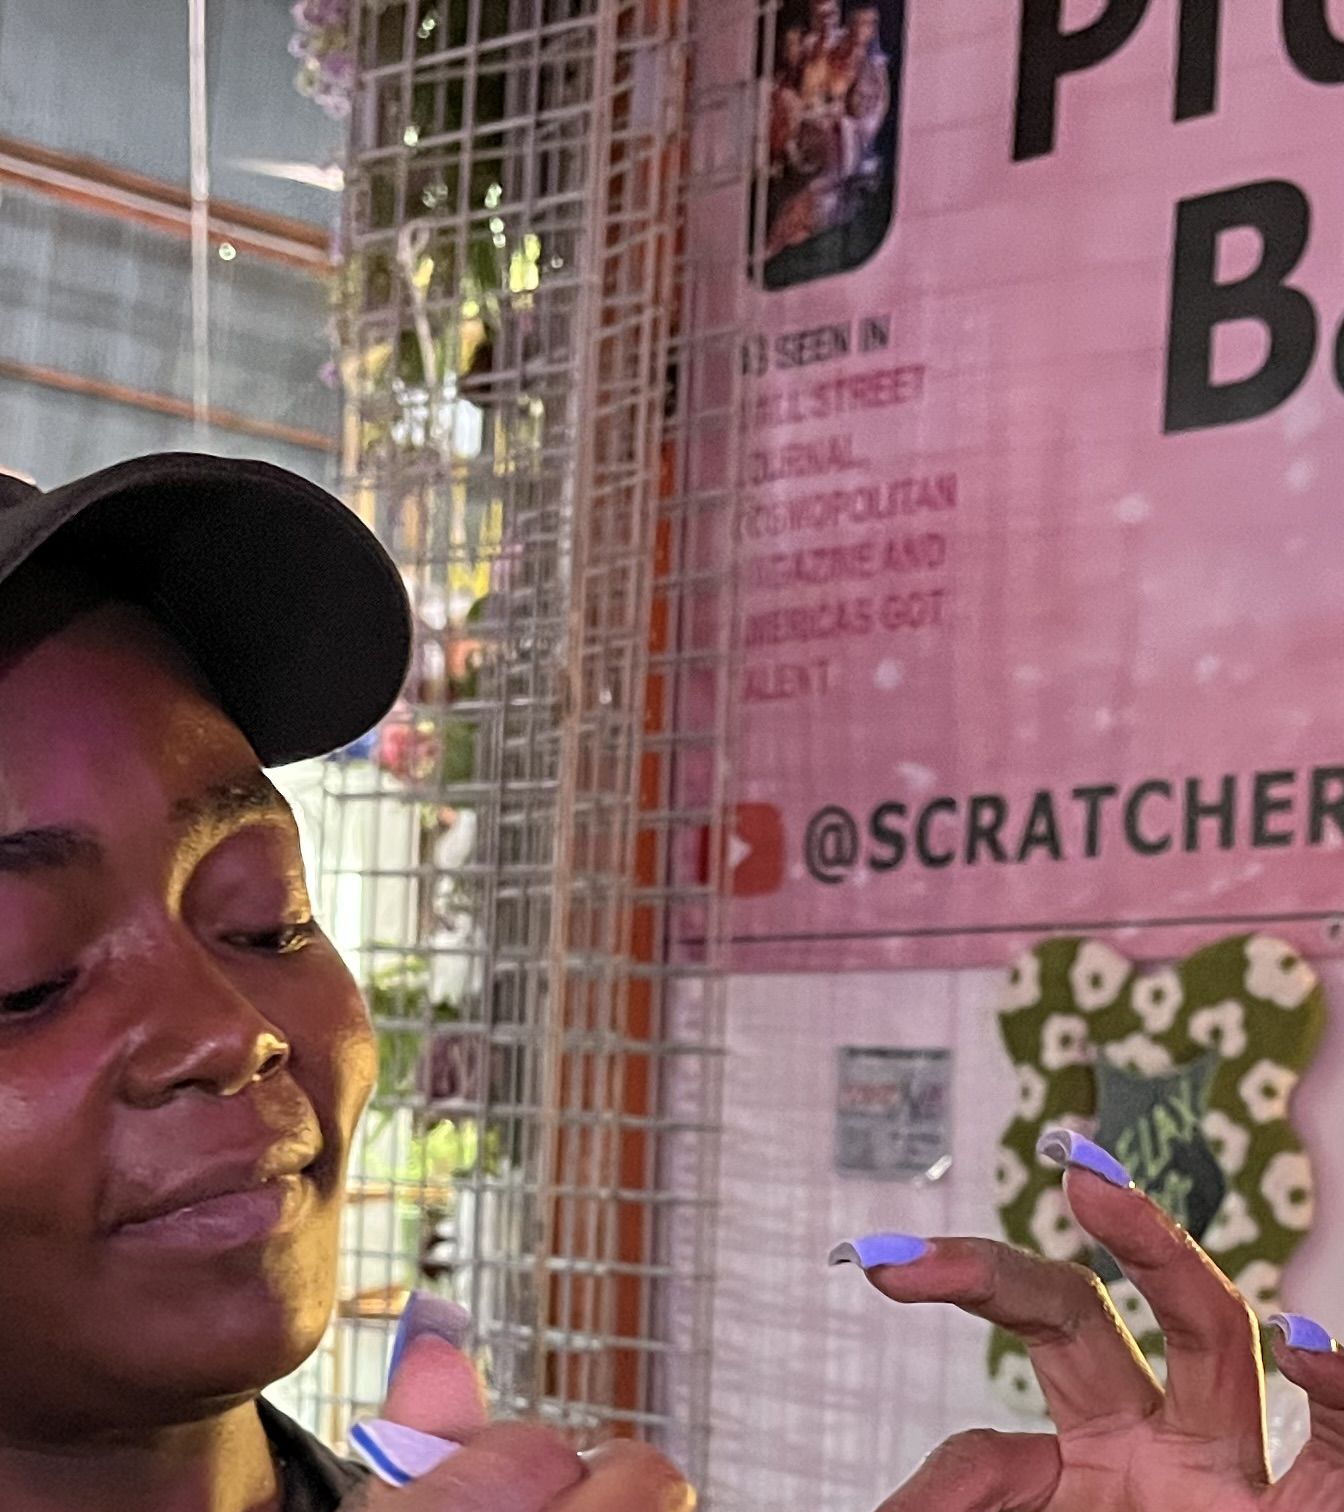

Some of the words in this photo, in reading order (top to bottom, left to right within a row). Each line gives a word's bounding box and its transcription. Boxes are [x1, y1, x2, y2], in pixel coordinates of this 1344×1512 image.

[774, 320, 852, 370] SEEN
[857, 313, 892, 353] IN
[883, 530, 947, 572] AND
[879, 587, 946, 632] GOT
